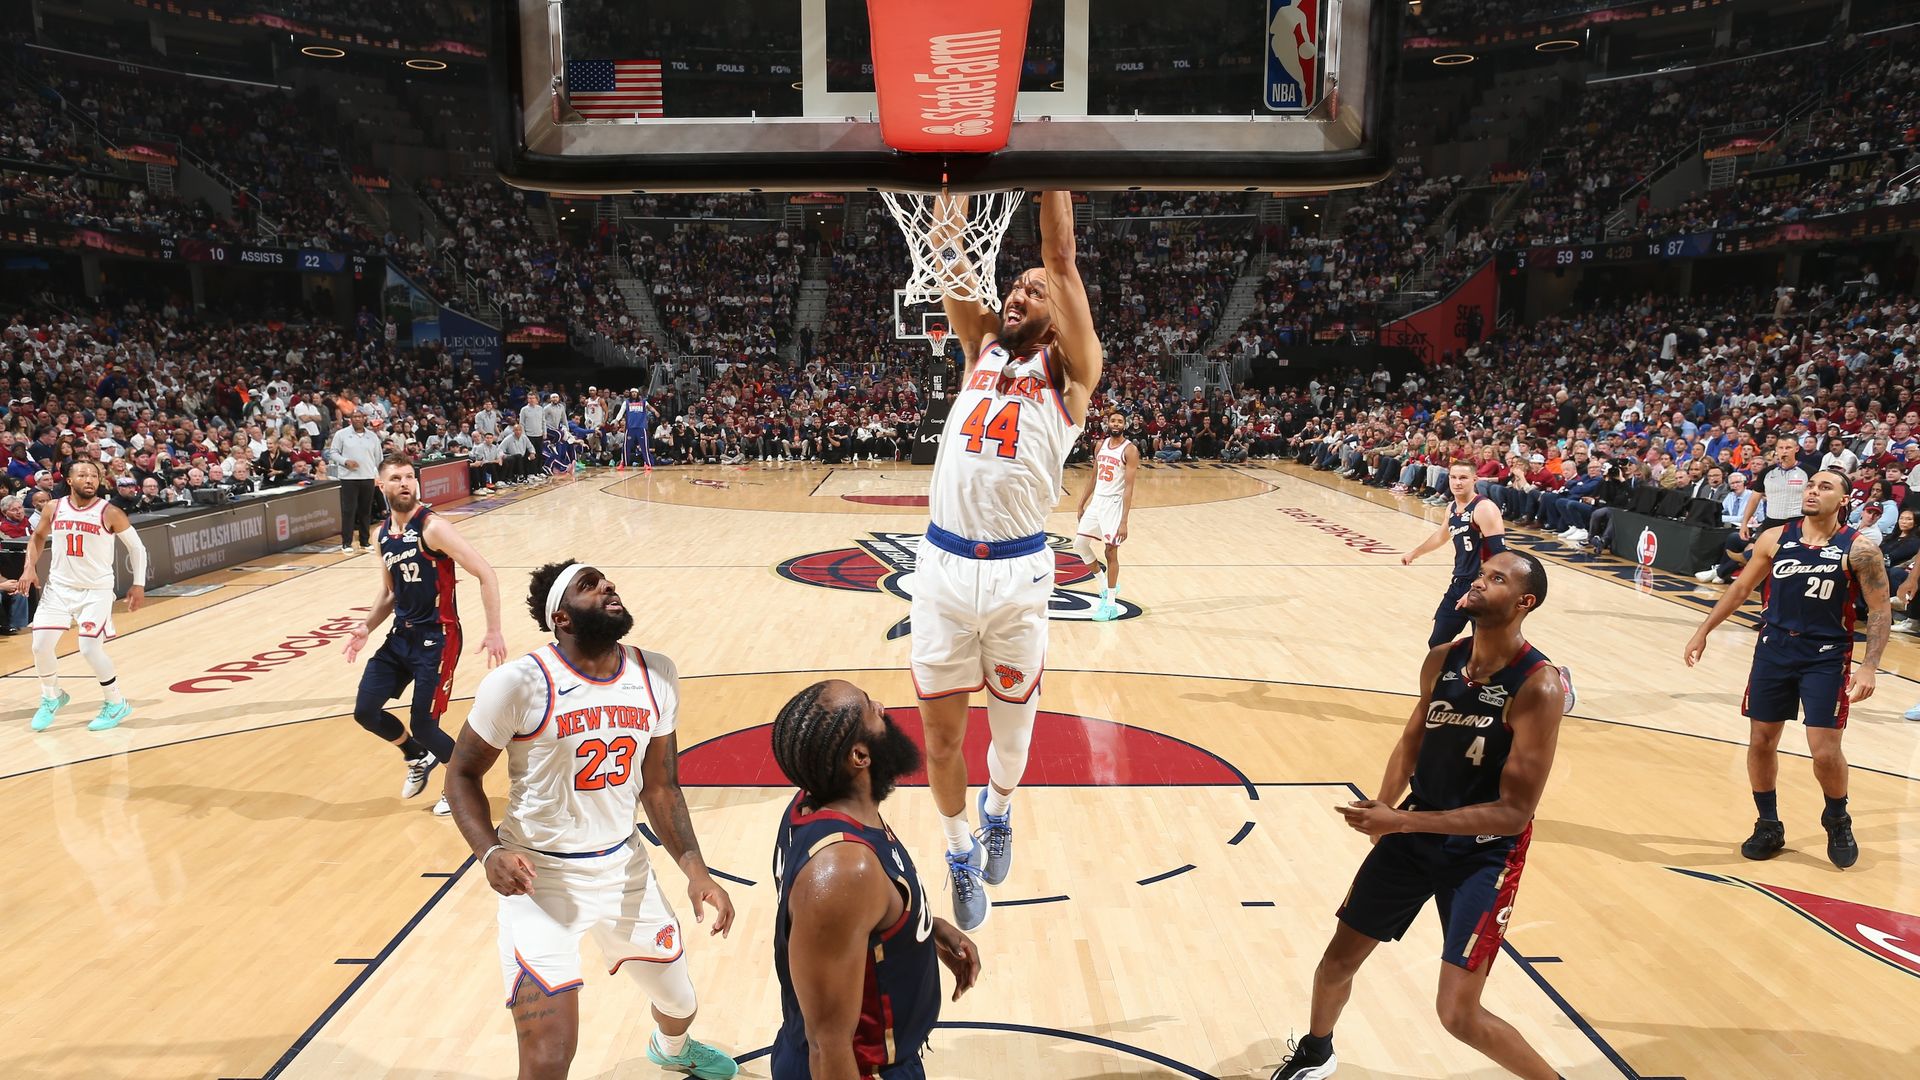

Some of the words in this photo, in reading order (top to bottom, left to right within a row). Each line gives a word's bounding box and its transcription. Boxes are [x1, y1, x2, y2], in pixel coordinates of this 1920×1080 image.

[671, 61, 689, 70] TOL
[716, 64, 745, 73] FOULS
[770, 65, 791, 74] FG%
[1116, 62, 1145, 71] FOULS
[1173, 60, 1191, 69] TOL
[1272, 83, 1296, 103] NBA
[163, 250, 173, 259] 37
[1556, 250, 1574, 265] 59
[1605, 245, 1633, 260] 4:28
[1648, 244, 1661, 256] 16
[1667, 240, 1684, 256] 87
[1716, 241, 1723, 252] 4
[209, 247, 224, 261] 10
[241, 250, 284, 264] ASSISTS
[304, 255, 321, 268] 22
[1518, 258, 1525, 268] 3
[933, 375, 942, 384] GET
[933, 383, 943, 391] THE
[960, 397, 1021, 459] 44
[1098, 463, 1115, 482] 25
[424, 477, 449, 498] ESPN
[54, 520, 74, 531] NEW
[75, 520, 101, 535] YORK
[171, 532, 200, 557] WWE
[199, 524, 231, 549] CLASH
[231, 522, 241, 542] IN
[240, 516, 264, 540] ITALY
[66, 533, 84, 557] 11
[1463, 536, 1473, 551] 5
[174, 558, 201, 575] SUNDAY
[202, 557, 207, 567] 2
[207, 553, 218, 566] PM
[218, 550, 225, 562] ET
[400, 562, 422, 583] 32
[1772, 558, 1839, 579] CLEVELAND
[1804, 576, 1835, 600] 20
[1479, 693, 1504, 706] CLIFFS
[555, 706, 603, 739] NEW
[603, 705, 650, 732] YORK
[1425, 700, 1494, 728] CLEVELAND
[1465, 735, 1486, 766] 4
[574, 736, 638, 791] 23
